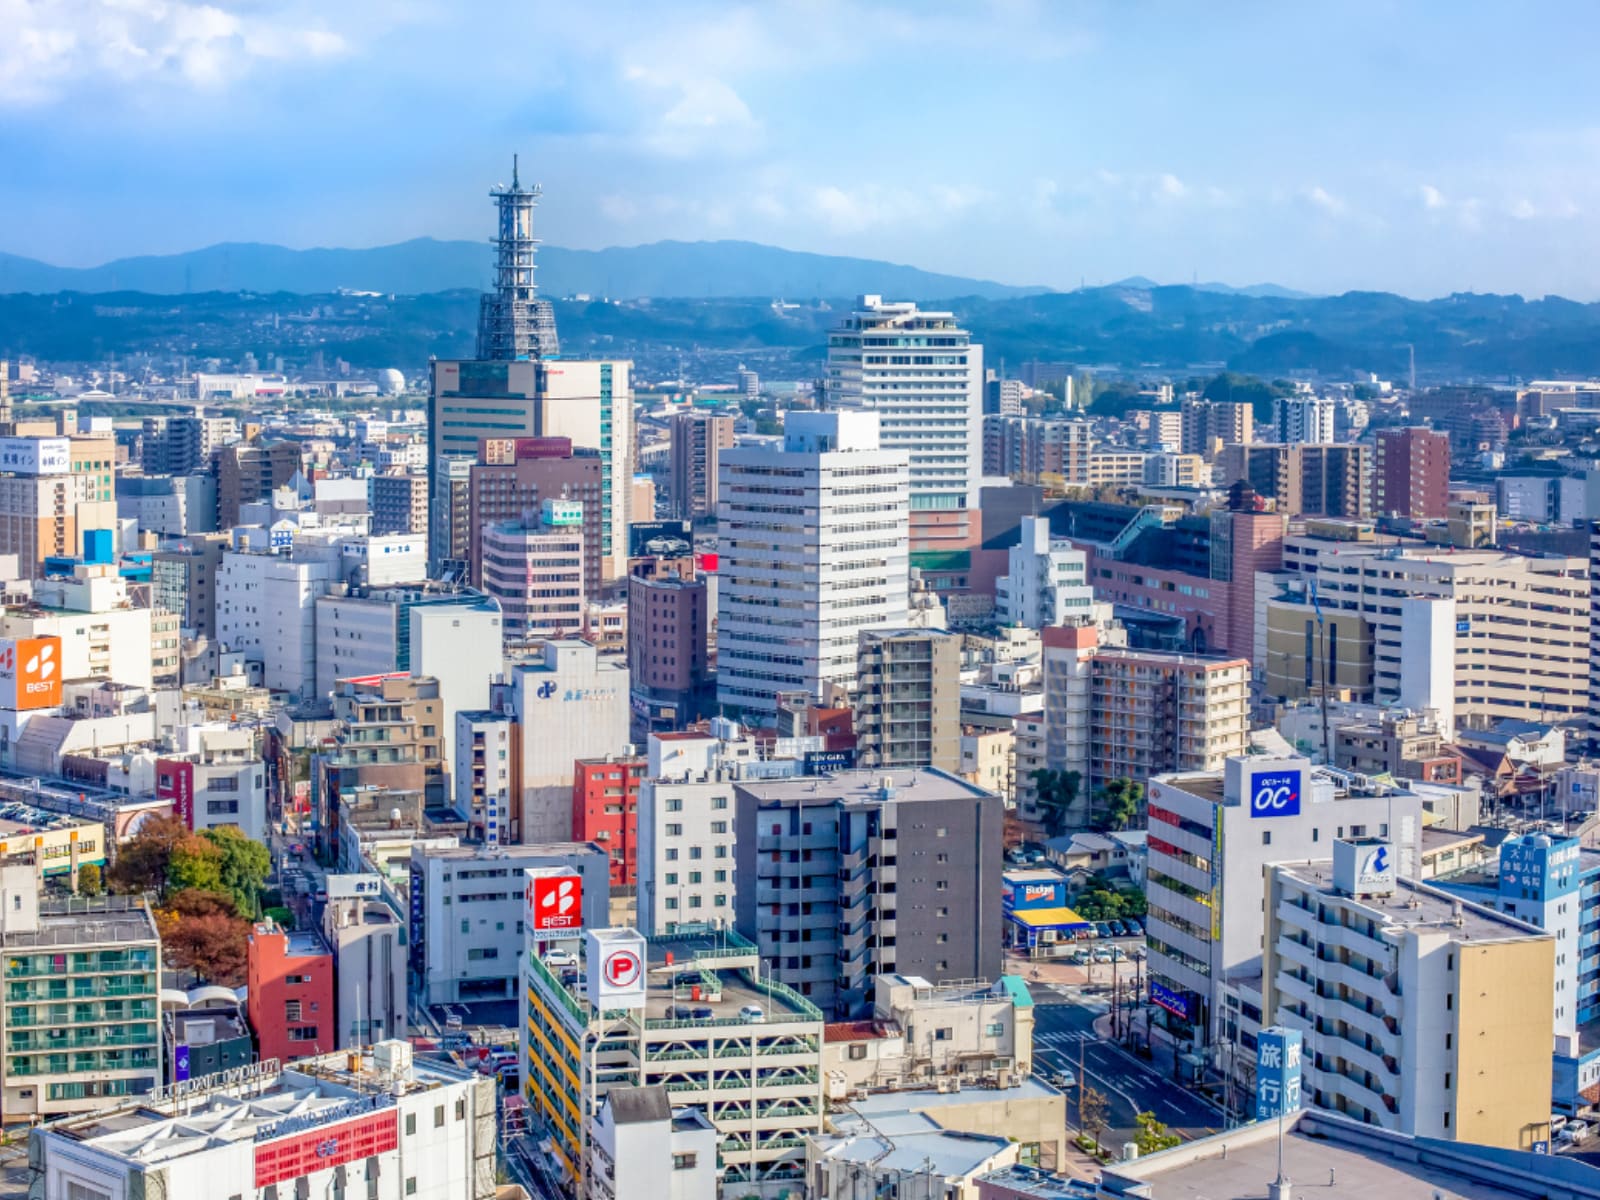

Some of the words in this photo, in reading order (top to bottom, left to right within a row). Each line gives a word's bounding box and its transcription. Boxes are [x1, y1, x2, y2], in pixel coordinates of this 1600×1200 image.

[26, 680, 55, 694] BEST
[1255, 786, 1291, 809] OC
[1025, 885, 1055, 897] Budget
[542, 914, 573, 927] BEST
[612, 957, 634, 979] P
[1260, 1042, 1281, 1103] 旅行
[1286, 1041, 1301, 1104] 旅行
